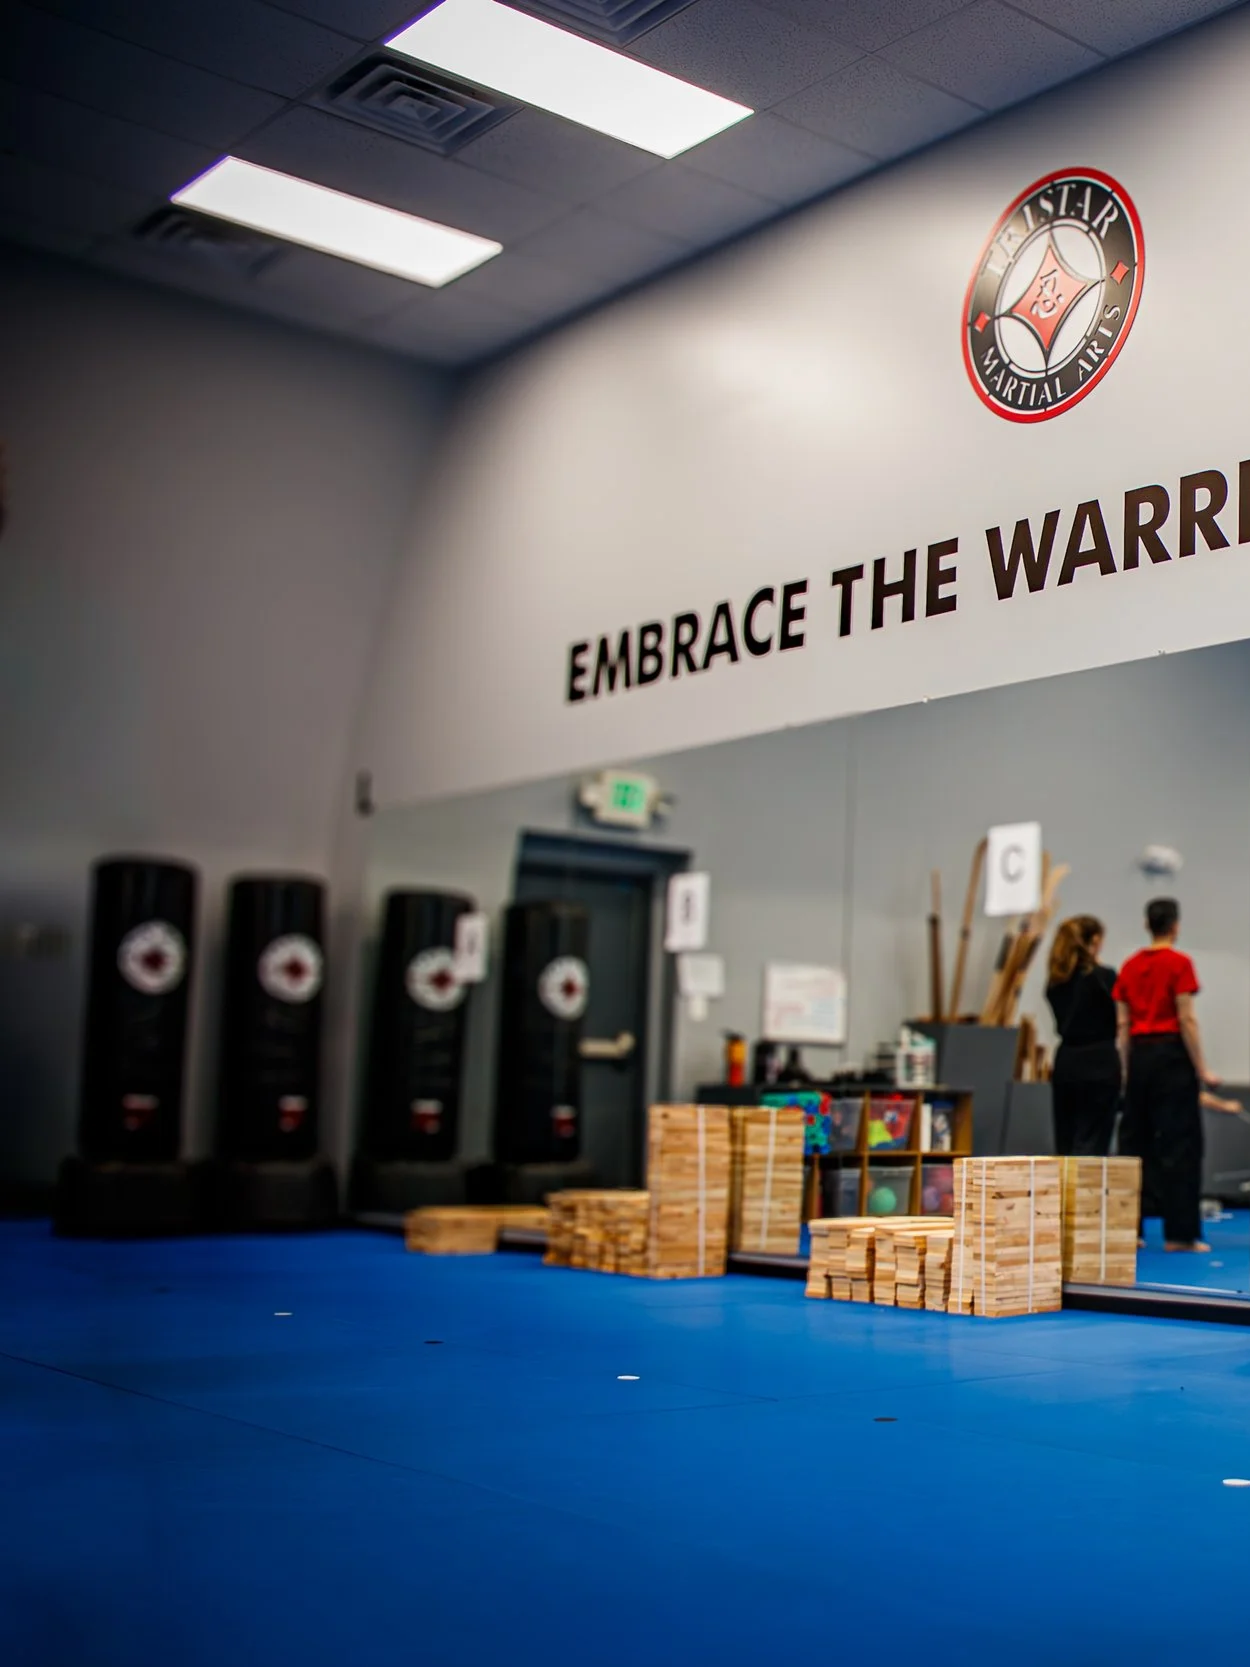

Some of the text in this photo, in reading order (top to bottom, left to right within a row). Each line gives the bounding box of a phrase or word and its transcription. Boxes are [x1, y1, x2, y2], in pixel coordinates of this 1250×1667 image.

[979, 182, 1120, 277] TRISTAR
[980, 303, 1122, 407] MARTIAL ARTS
[567, 577, 808, 703] EMBRACE
[831, 536, 959, 638] THE
[1000, 843, 1027, 885] C
